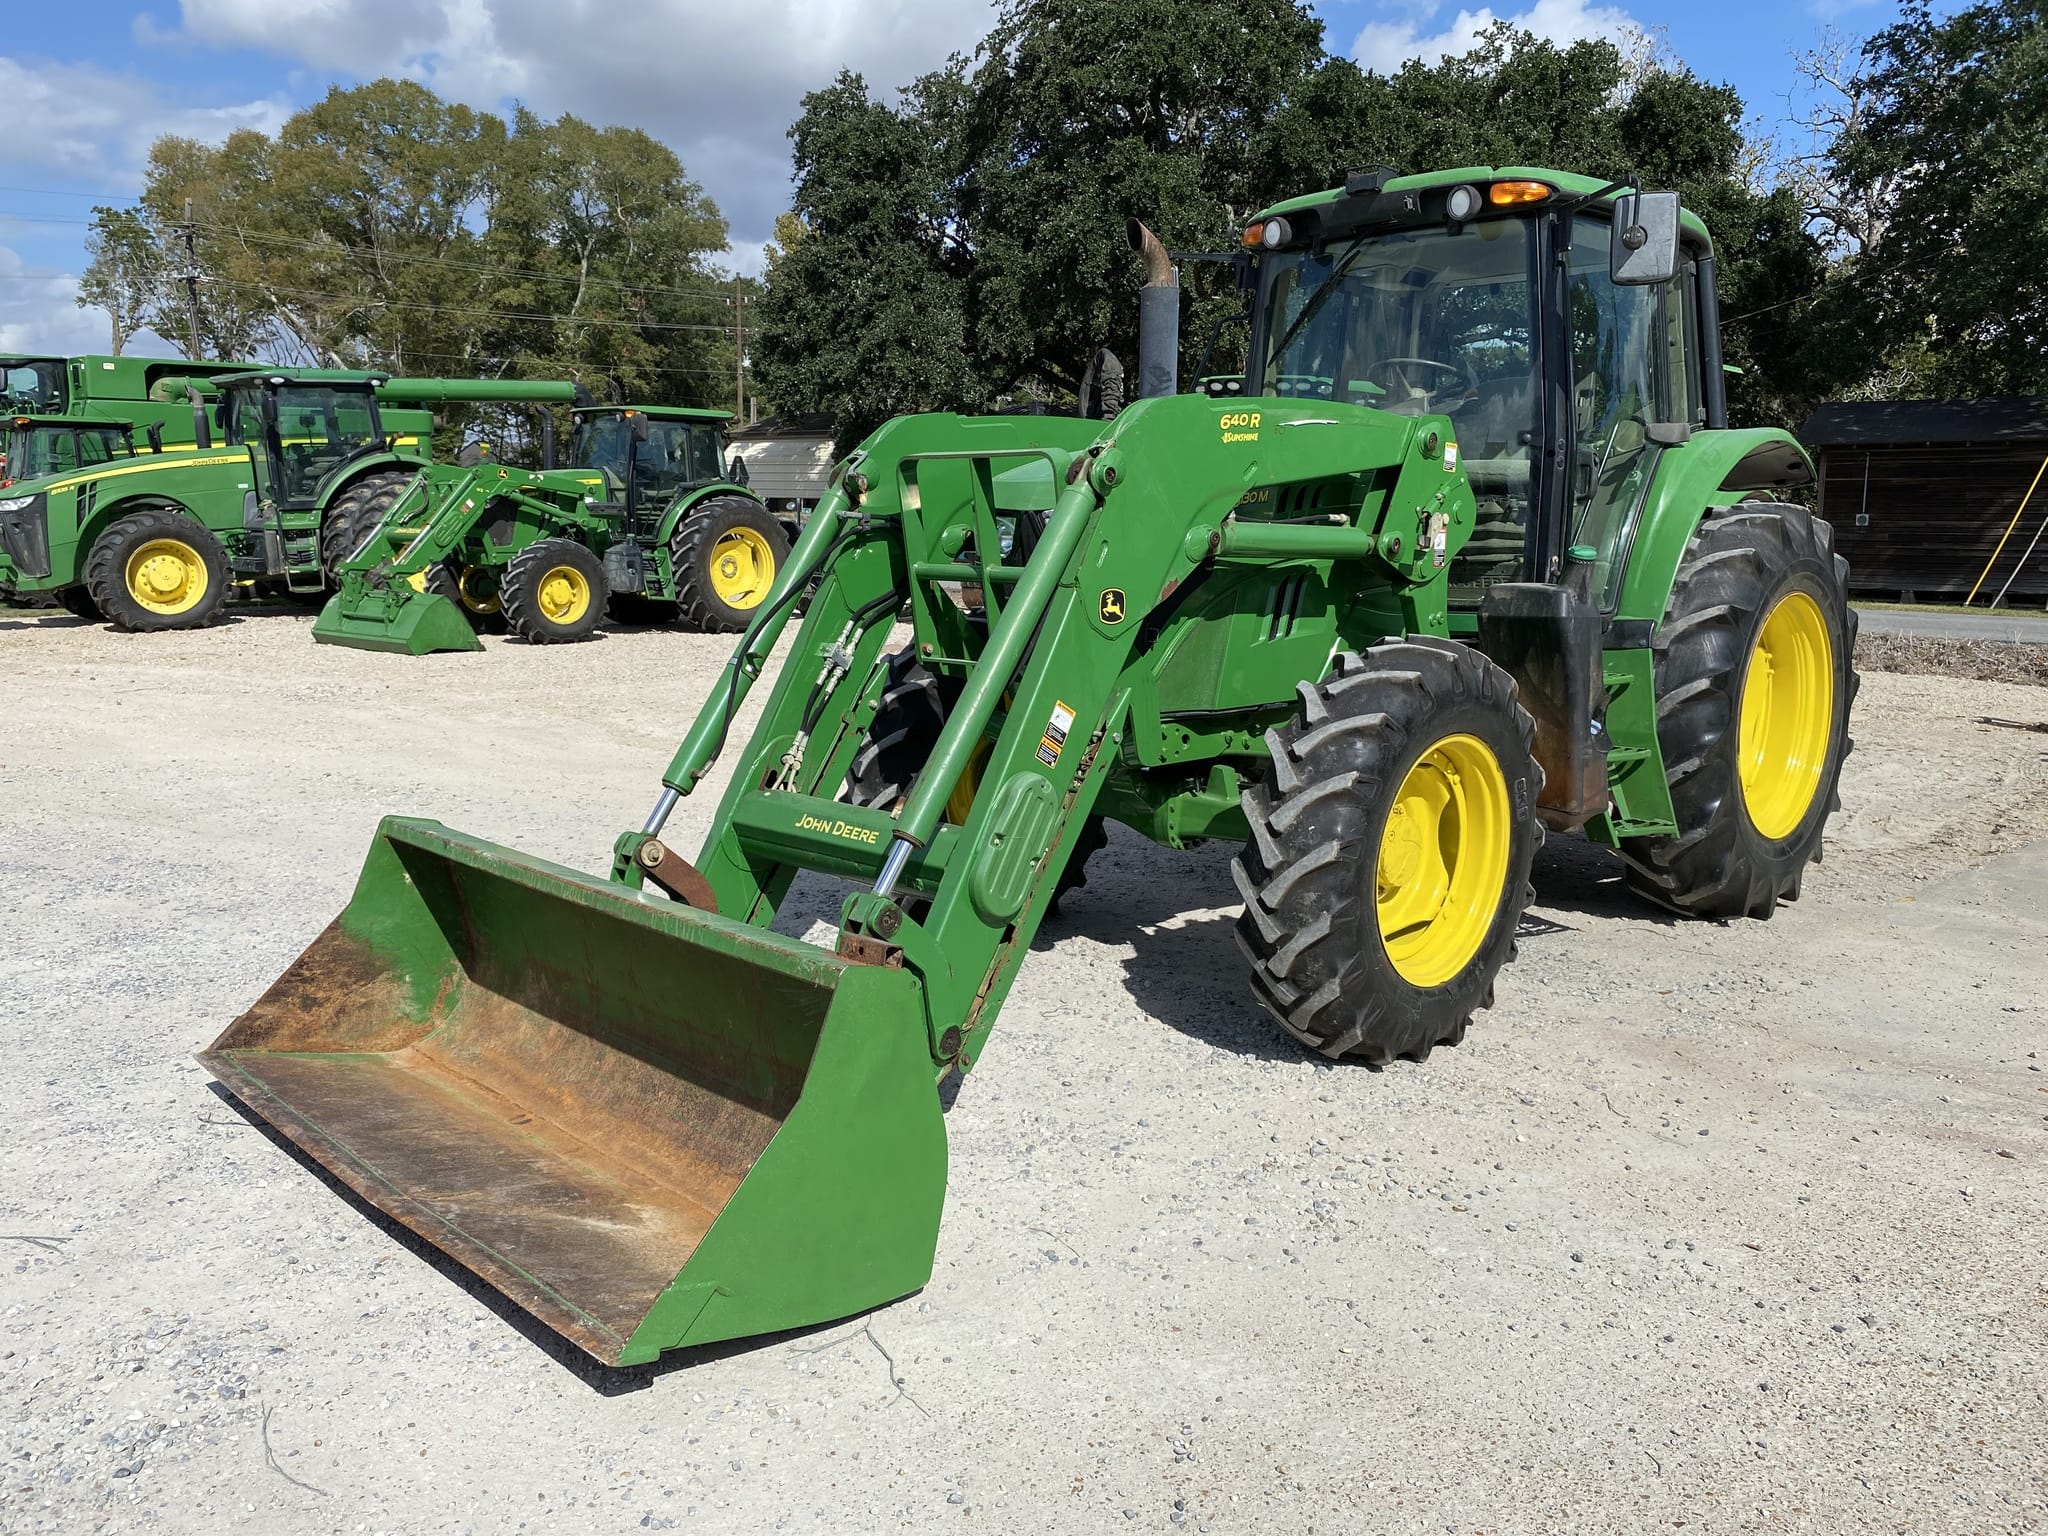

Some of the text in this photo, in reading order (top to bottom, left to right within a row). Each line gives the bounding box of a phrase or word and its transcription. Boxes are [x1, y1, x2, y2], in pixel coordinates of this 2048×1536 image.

[1227, 431, 1259, 442] SUNSHINE
[794, 813, 880, 845] JOHN DEERE
